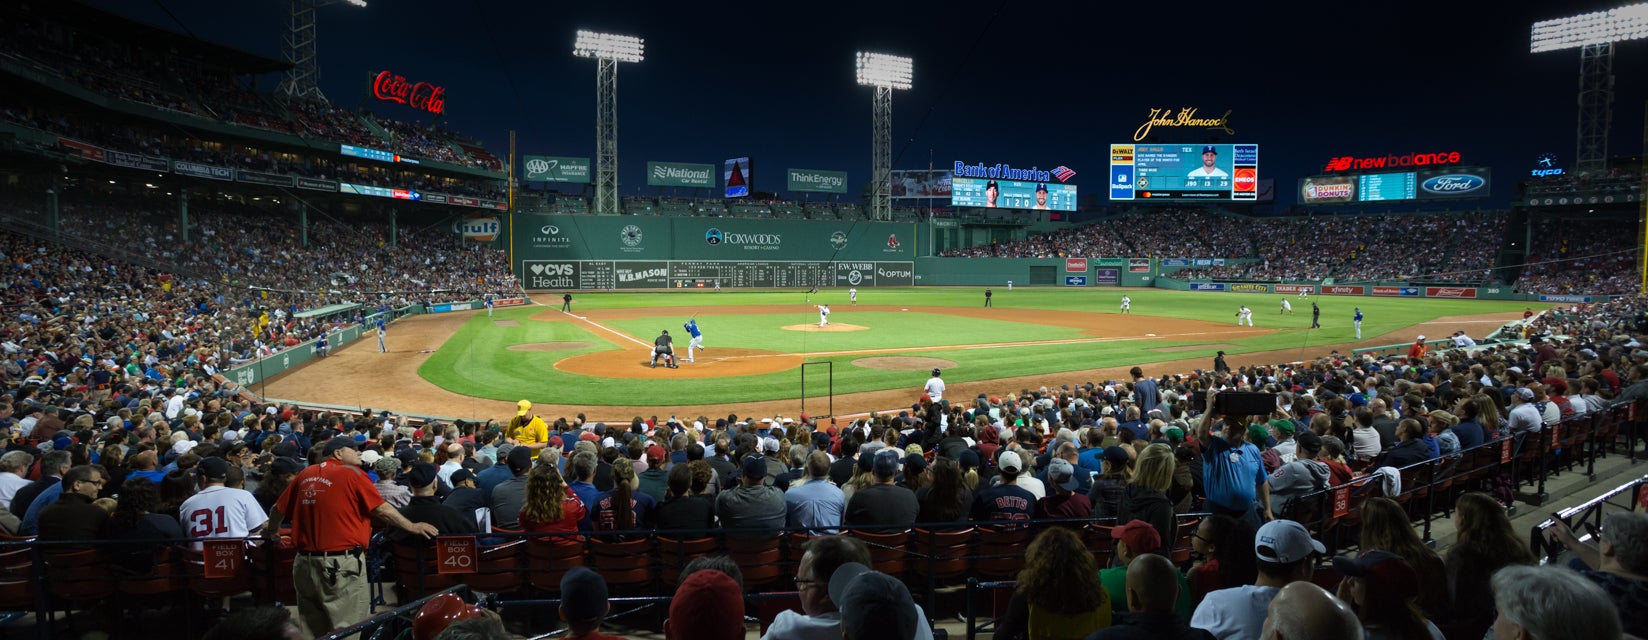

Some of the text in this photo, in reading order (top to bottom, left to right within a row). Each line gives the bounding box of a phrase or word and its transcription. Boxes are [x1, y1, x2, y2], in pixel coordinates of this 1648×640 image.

[373, 70, 445, 114] Coca-Cola
[1133, 107, 1235, 141] John Hancock
[1354, 156, 1387, 170] new
[1387, 151, 1461, 167] balance
[210, 167, 230, 177] TECH
[666, 167, 710, 179] National
[954, 160, 1050, 181] Bank of America
[1531, 168, 1562, 177] tyco
[1433, 177, 1472, 191] Ford
[1024, 199, 1029, 207] 0
[724, 231, 781, 244] FOXWOODS
[544, 264, 574, 275] CVS
[532, 276, 574, 288] Health
[1331, 286, 1353, 294] xfinity
[995, 496, 1028, 511] BETTS
[1335, 500, 1346, 511] 38
[190, 505, 228, 537] 31
[215, 559, 235, 570] 41
[444, 555, 471, 567] 40
